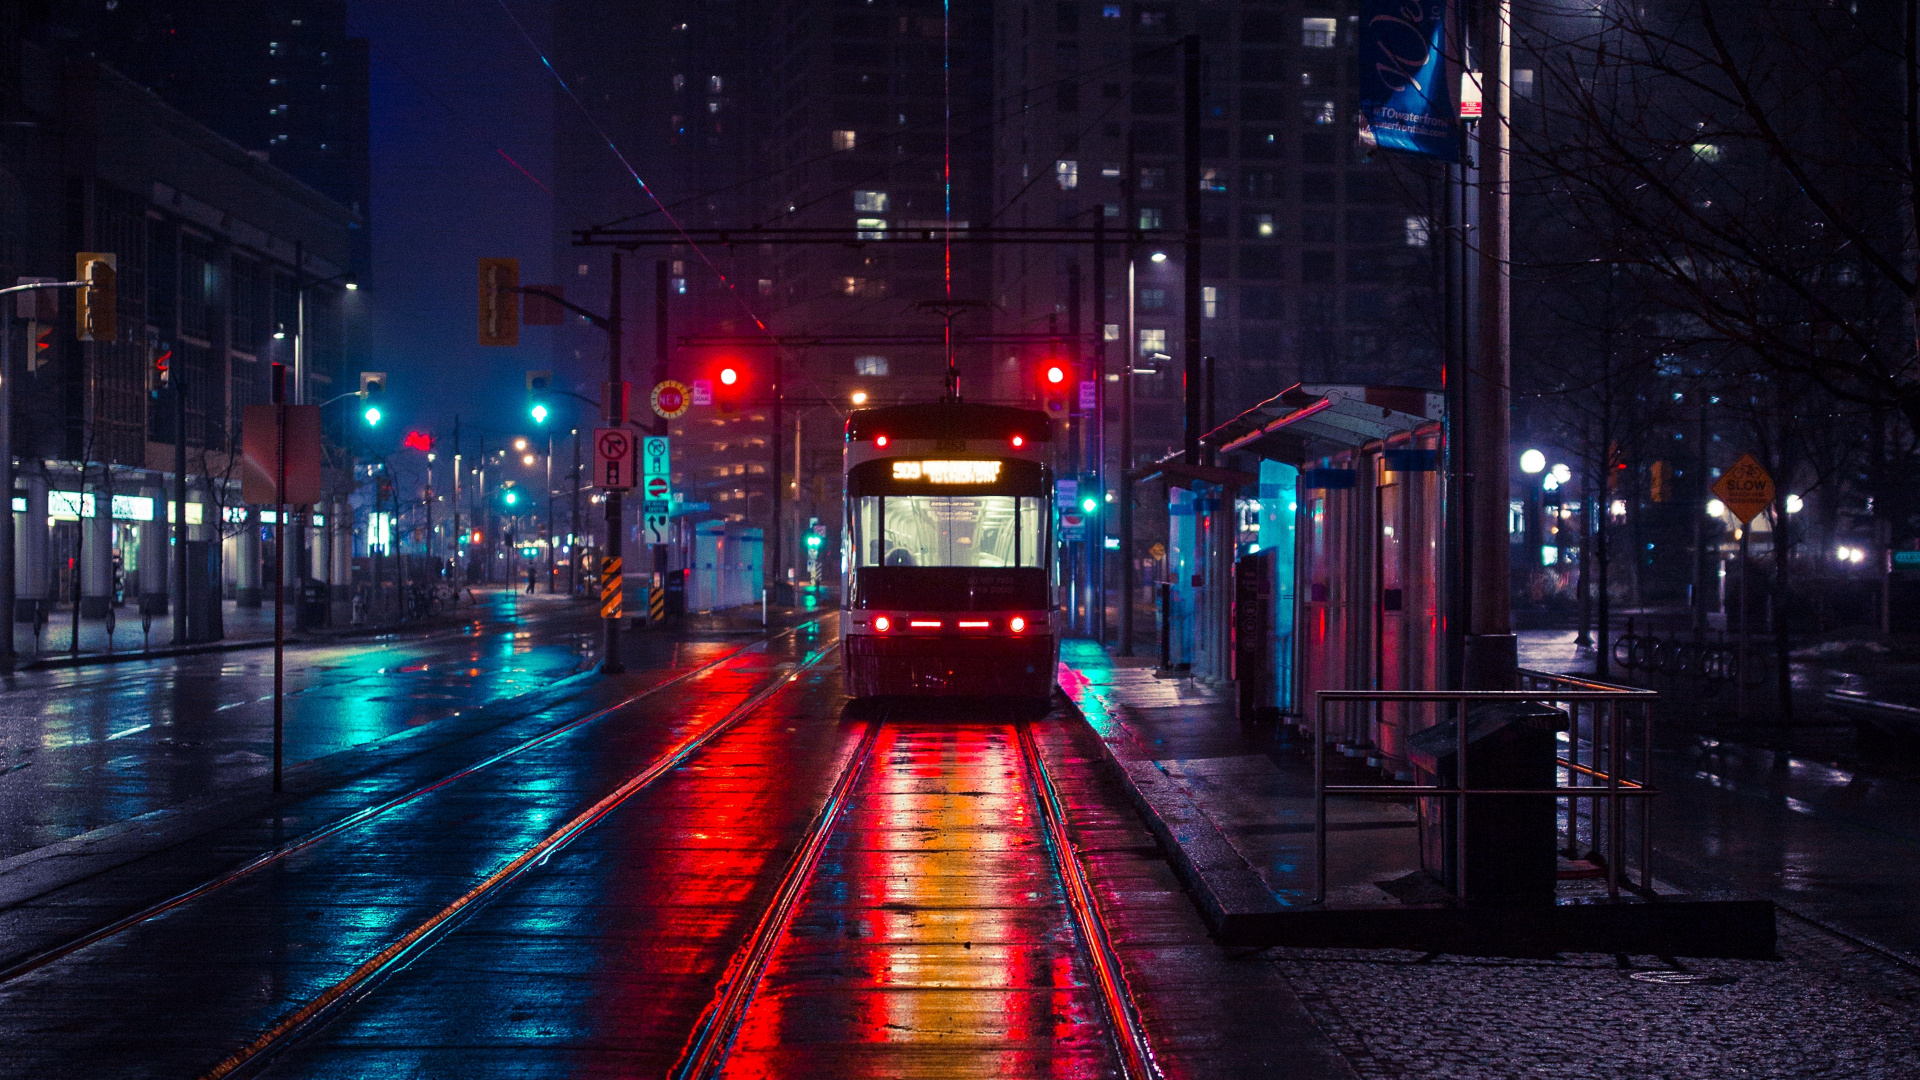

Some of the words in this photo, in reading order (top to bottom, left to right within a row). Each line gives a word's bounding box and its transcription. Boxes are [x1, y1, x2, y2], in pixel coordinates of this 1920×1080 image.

[658, 393, 681, 405] NEW
[892, 462, 921, 479] 509
[1727, 480, 1767, 490] SLOW
